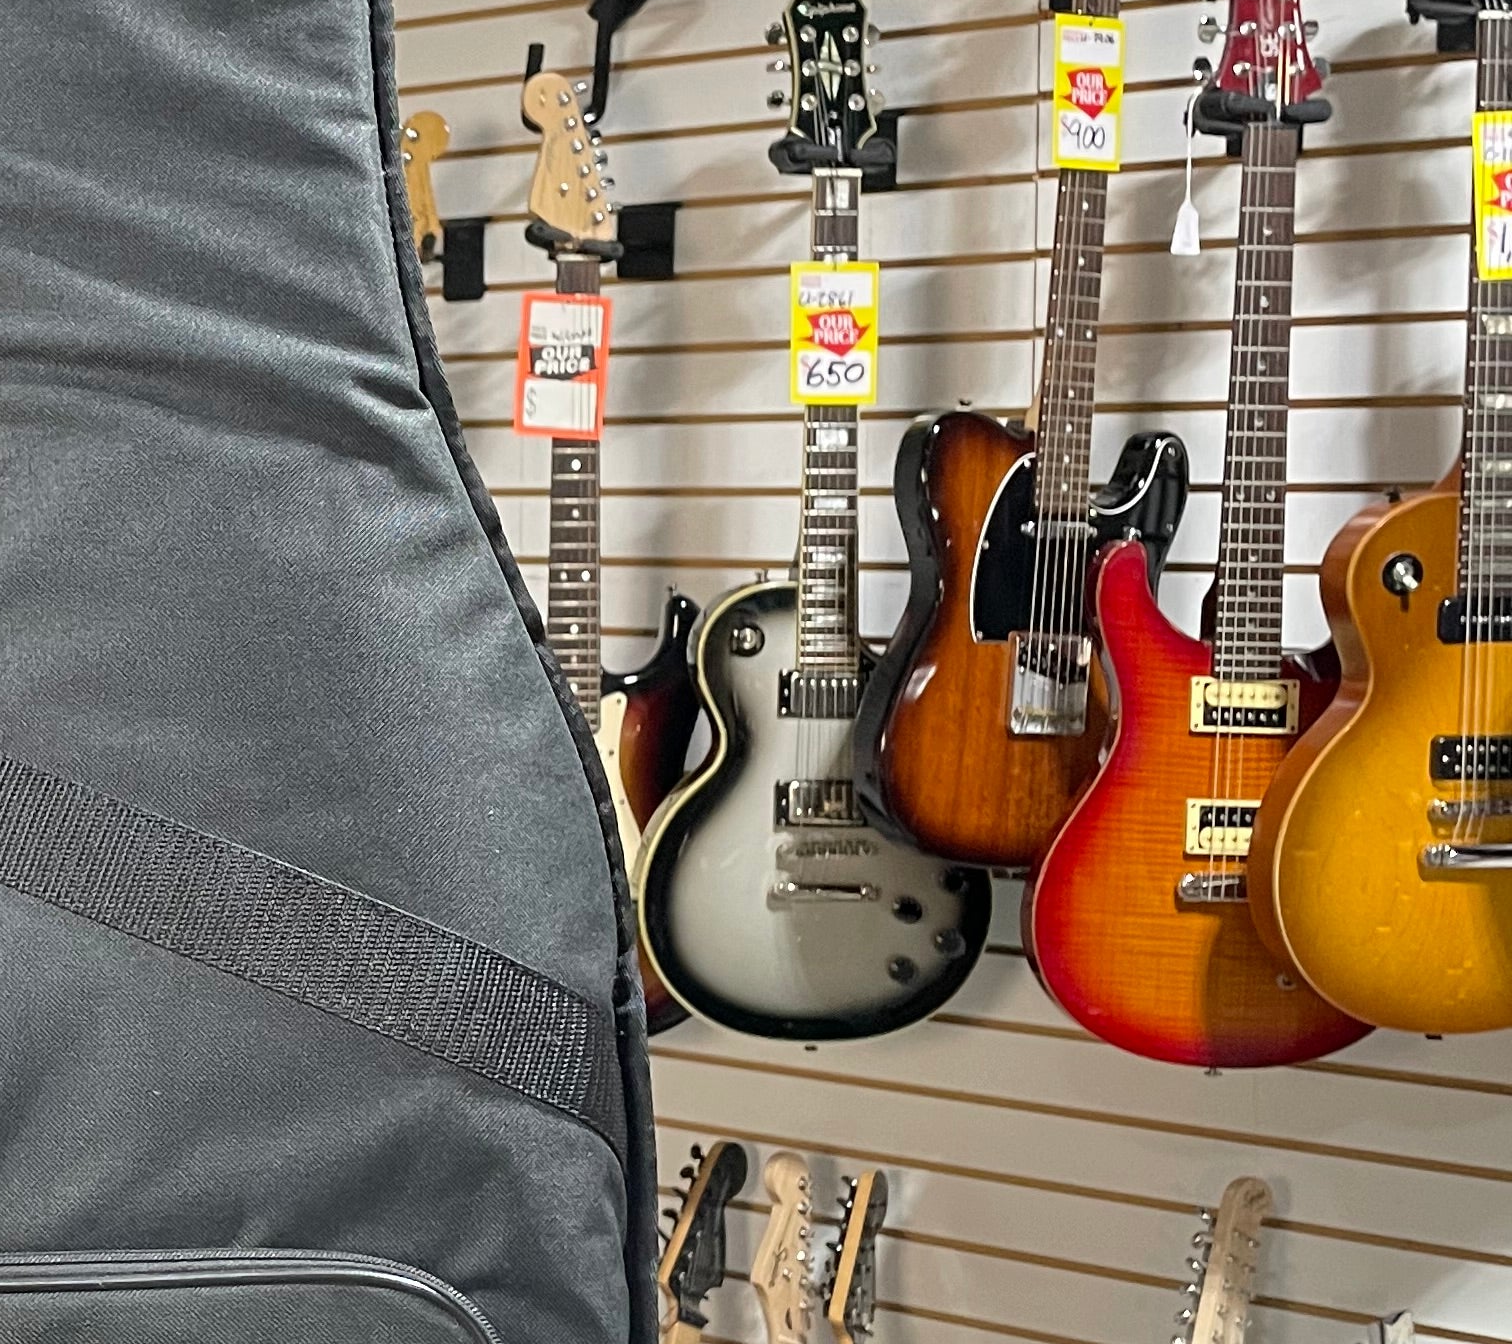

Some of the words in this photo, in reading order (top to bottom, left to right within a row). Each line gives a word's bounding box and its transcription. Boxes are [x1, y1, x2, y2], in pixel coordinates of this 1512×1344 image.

[1076, 72, 1104, 90] OUR
[1072, 89, 1108, 106] PRICE
[818, 314, 853, 330] OUR
[814, 329, 860, 345] PRICE
[541, 344, 582, 360] OUR
[534, 358, 591, 375] PRICE
